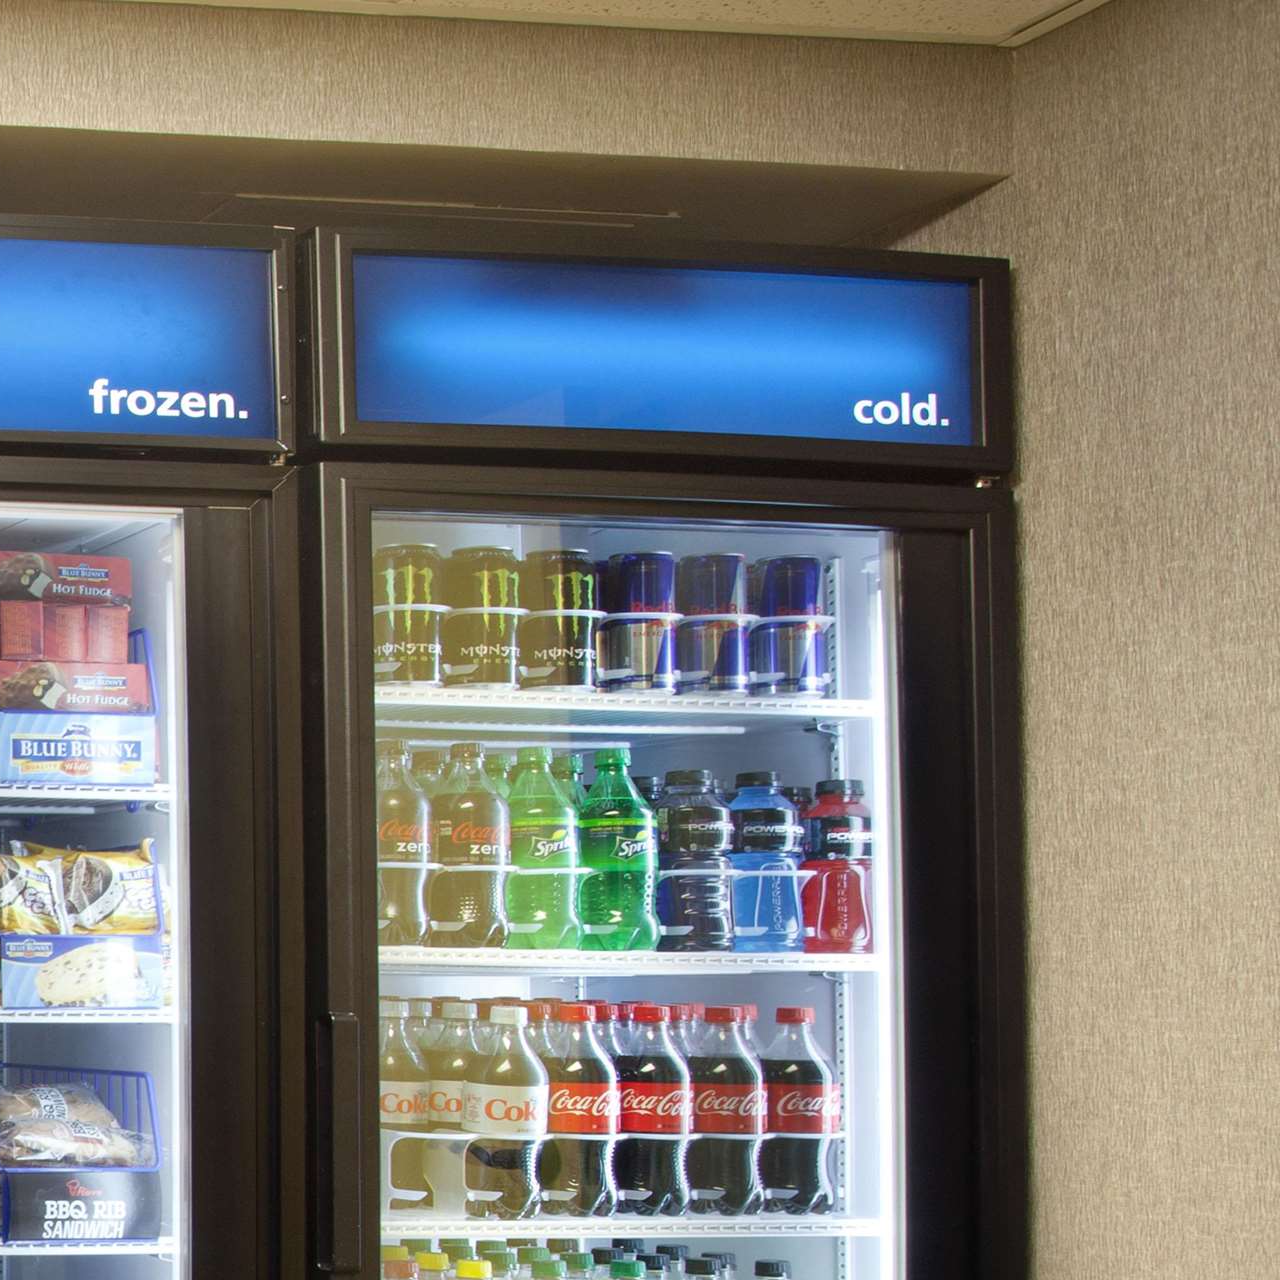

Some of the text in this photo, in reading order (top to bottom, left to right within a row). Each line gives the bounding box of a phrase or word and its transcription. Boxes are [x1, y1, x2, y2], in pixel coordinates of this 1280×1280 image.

[88, 380, 249, 420] frozen.
[853, 393, 950, 428] cold.
[61, 568, 107, 578] BLUE BUNNY
[53, 584, 112, 597] HOT FUDGE
[67, 694, 129, 706] HOT FUDGE
[21, 740, 137, 758] BLUE BUNNY
[485, 1099, 538, 1121] Cok
[44, 1200, 127, 1219] BBQ RIB
[42, 1220, 124, 1239] SANDWICH
